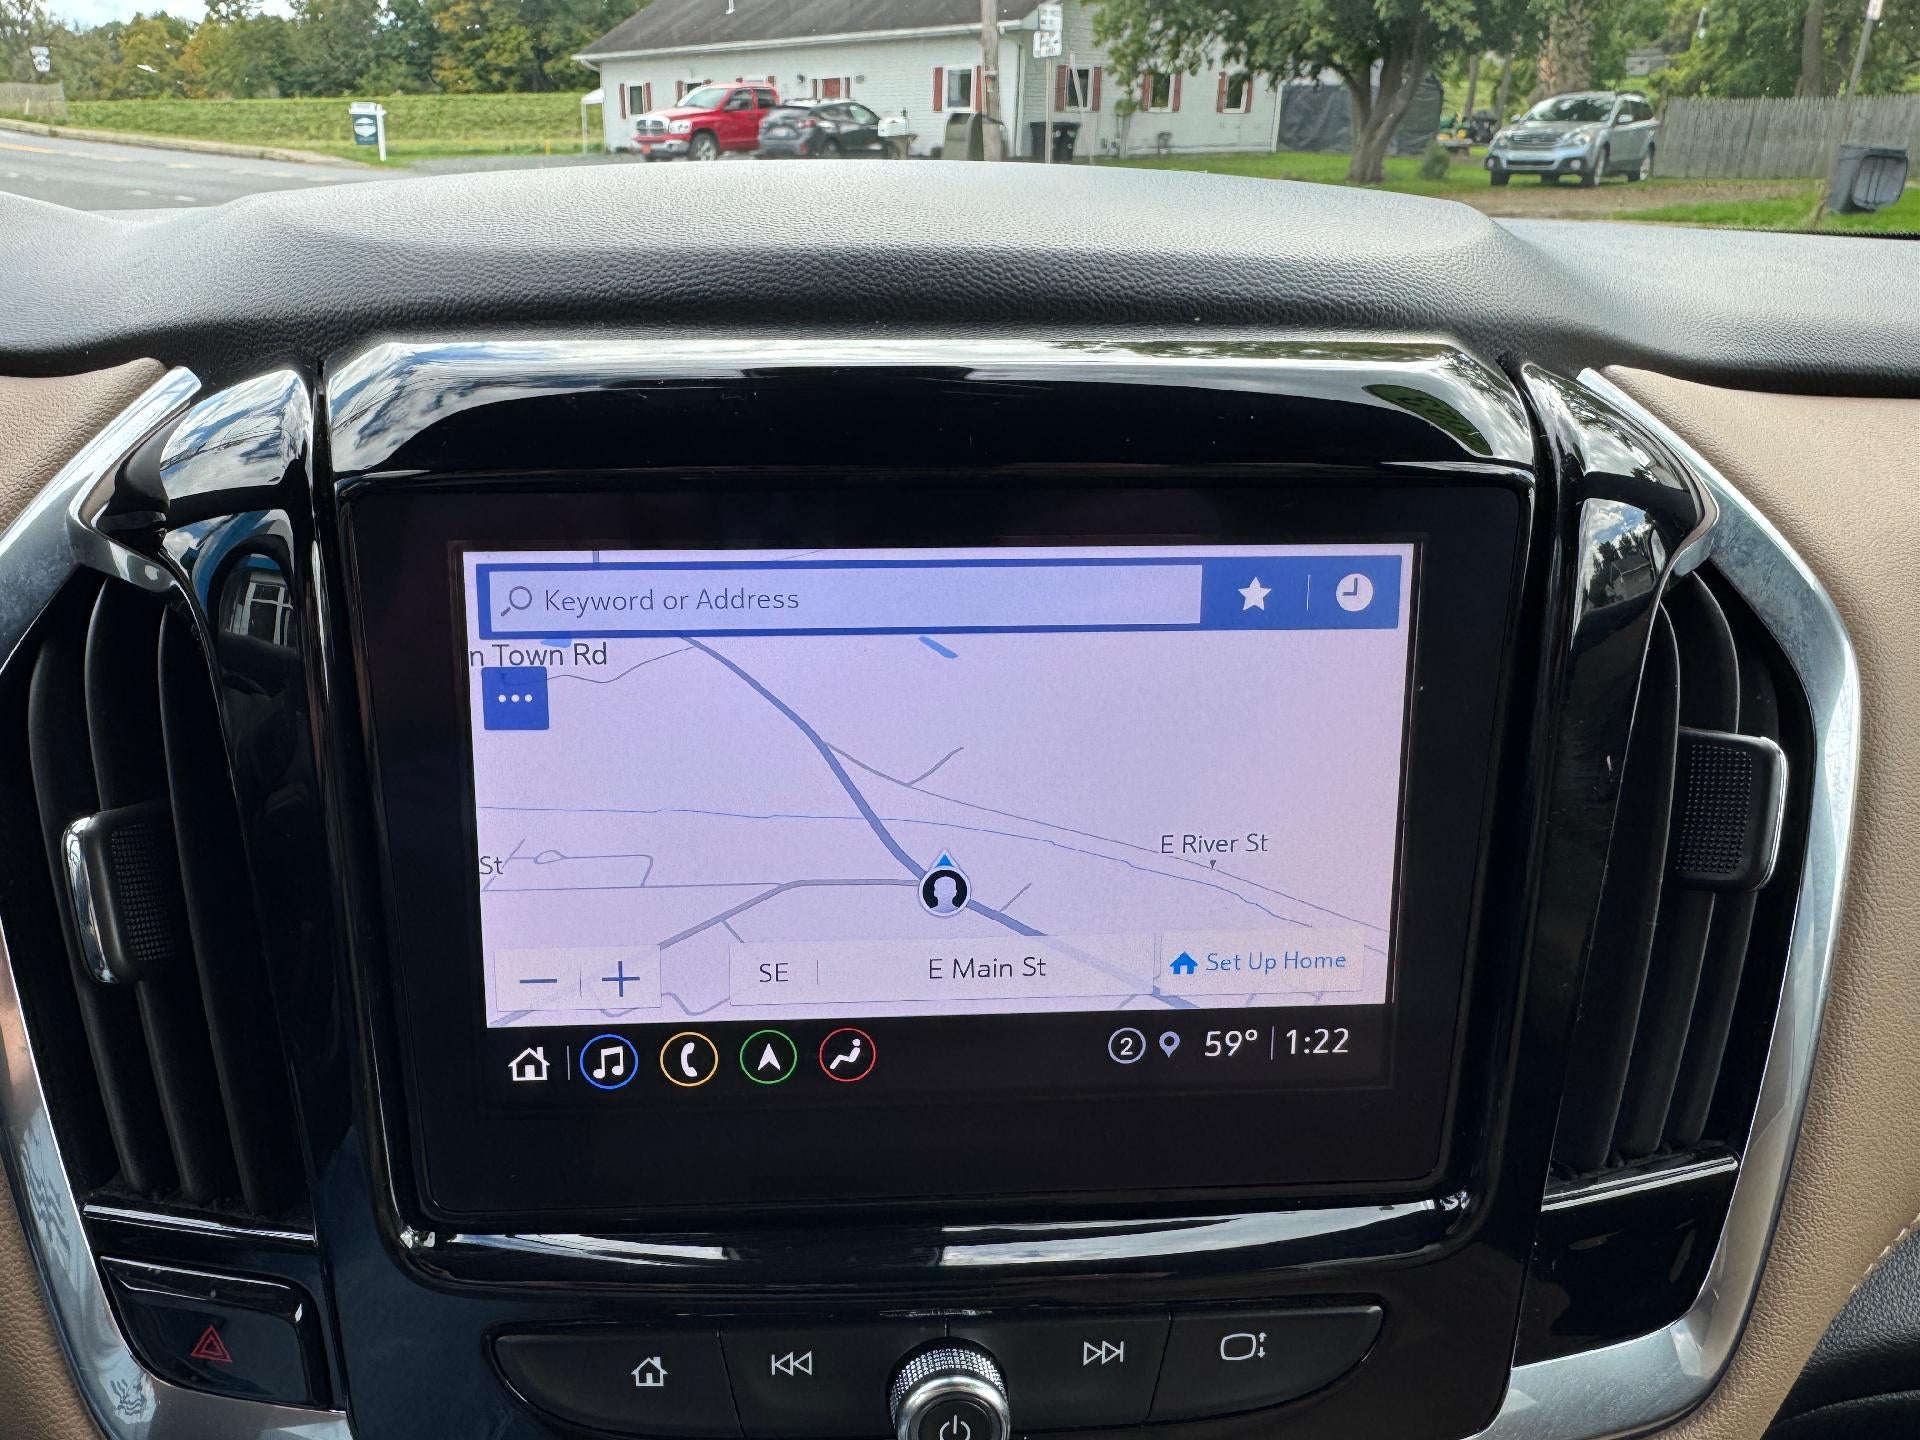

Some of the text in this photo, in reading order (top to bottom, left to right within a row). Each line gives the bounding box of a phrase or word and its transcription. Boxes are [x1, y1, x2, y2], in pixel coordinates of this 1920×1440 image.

[544, 588, 799, 618] Keyword or Address
[492, 643, 564, 666] Town
[574, 642, 608, 665] Rd
[1161, 832, 1268, 853] E River St
[479, 855, 504, 876] St
[759, 963, 790, 983] SE
[929, 957, 1047, 979] E Main St
[1205, 951, 1347, 975] Set Up Home
[1120, 1036, 1133, 1056] 2
[1286, 1028, 1350, 1055] 1:22
